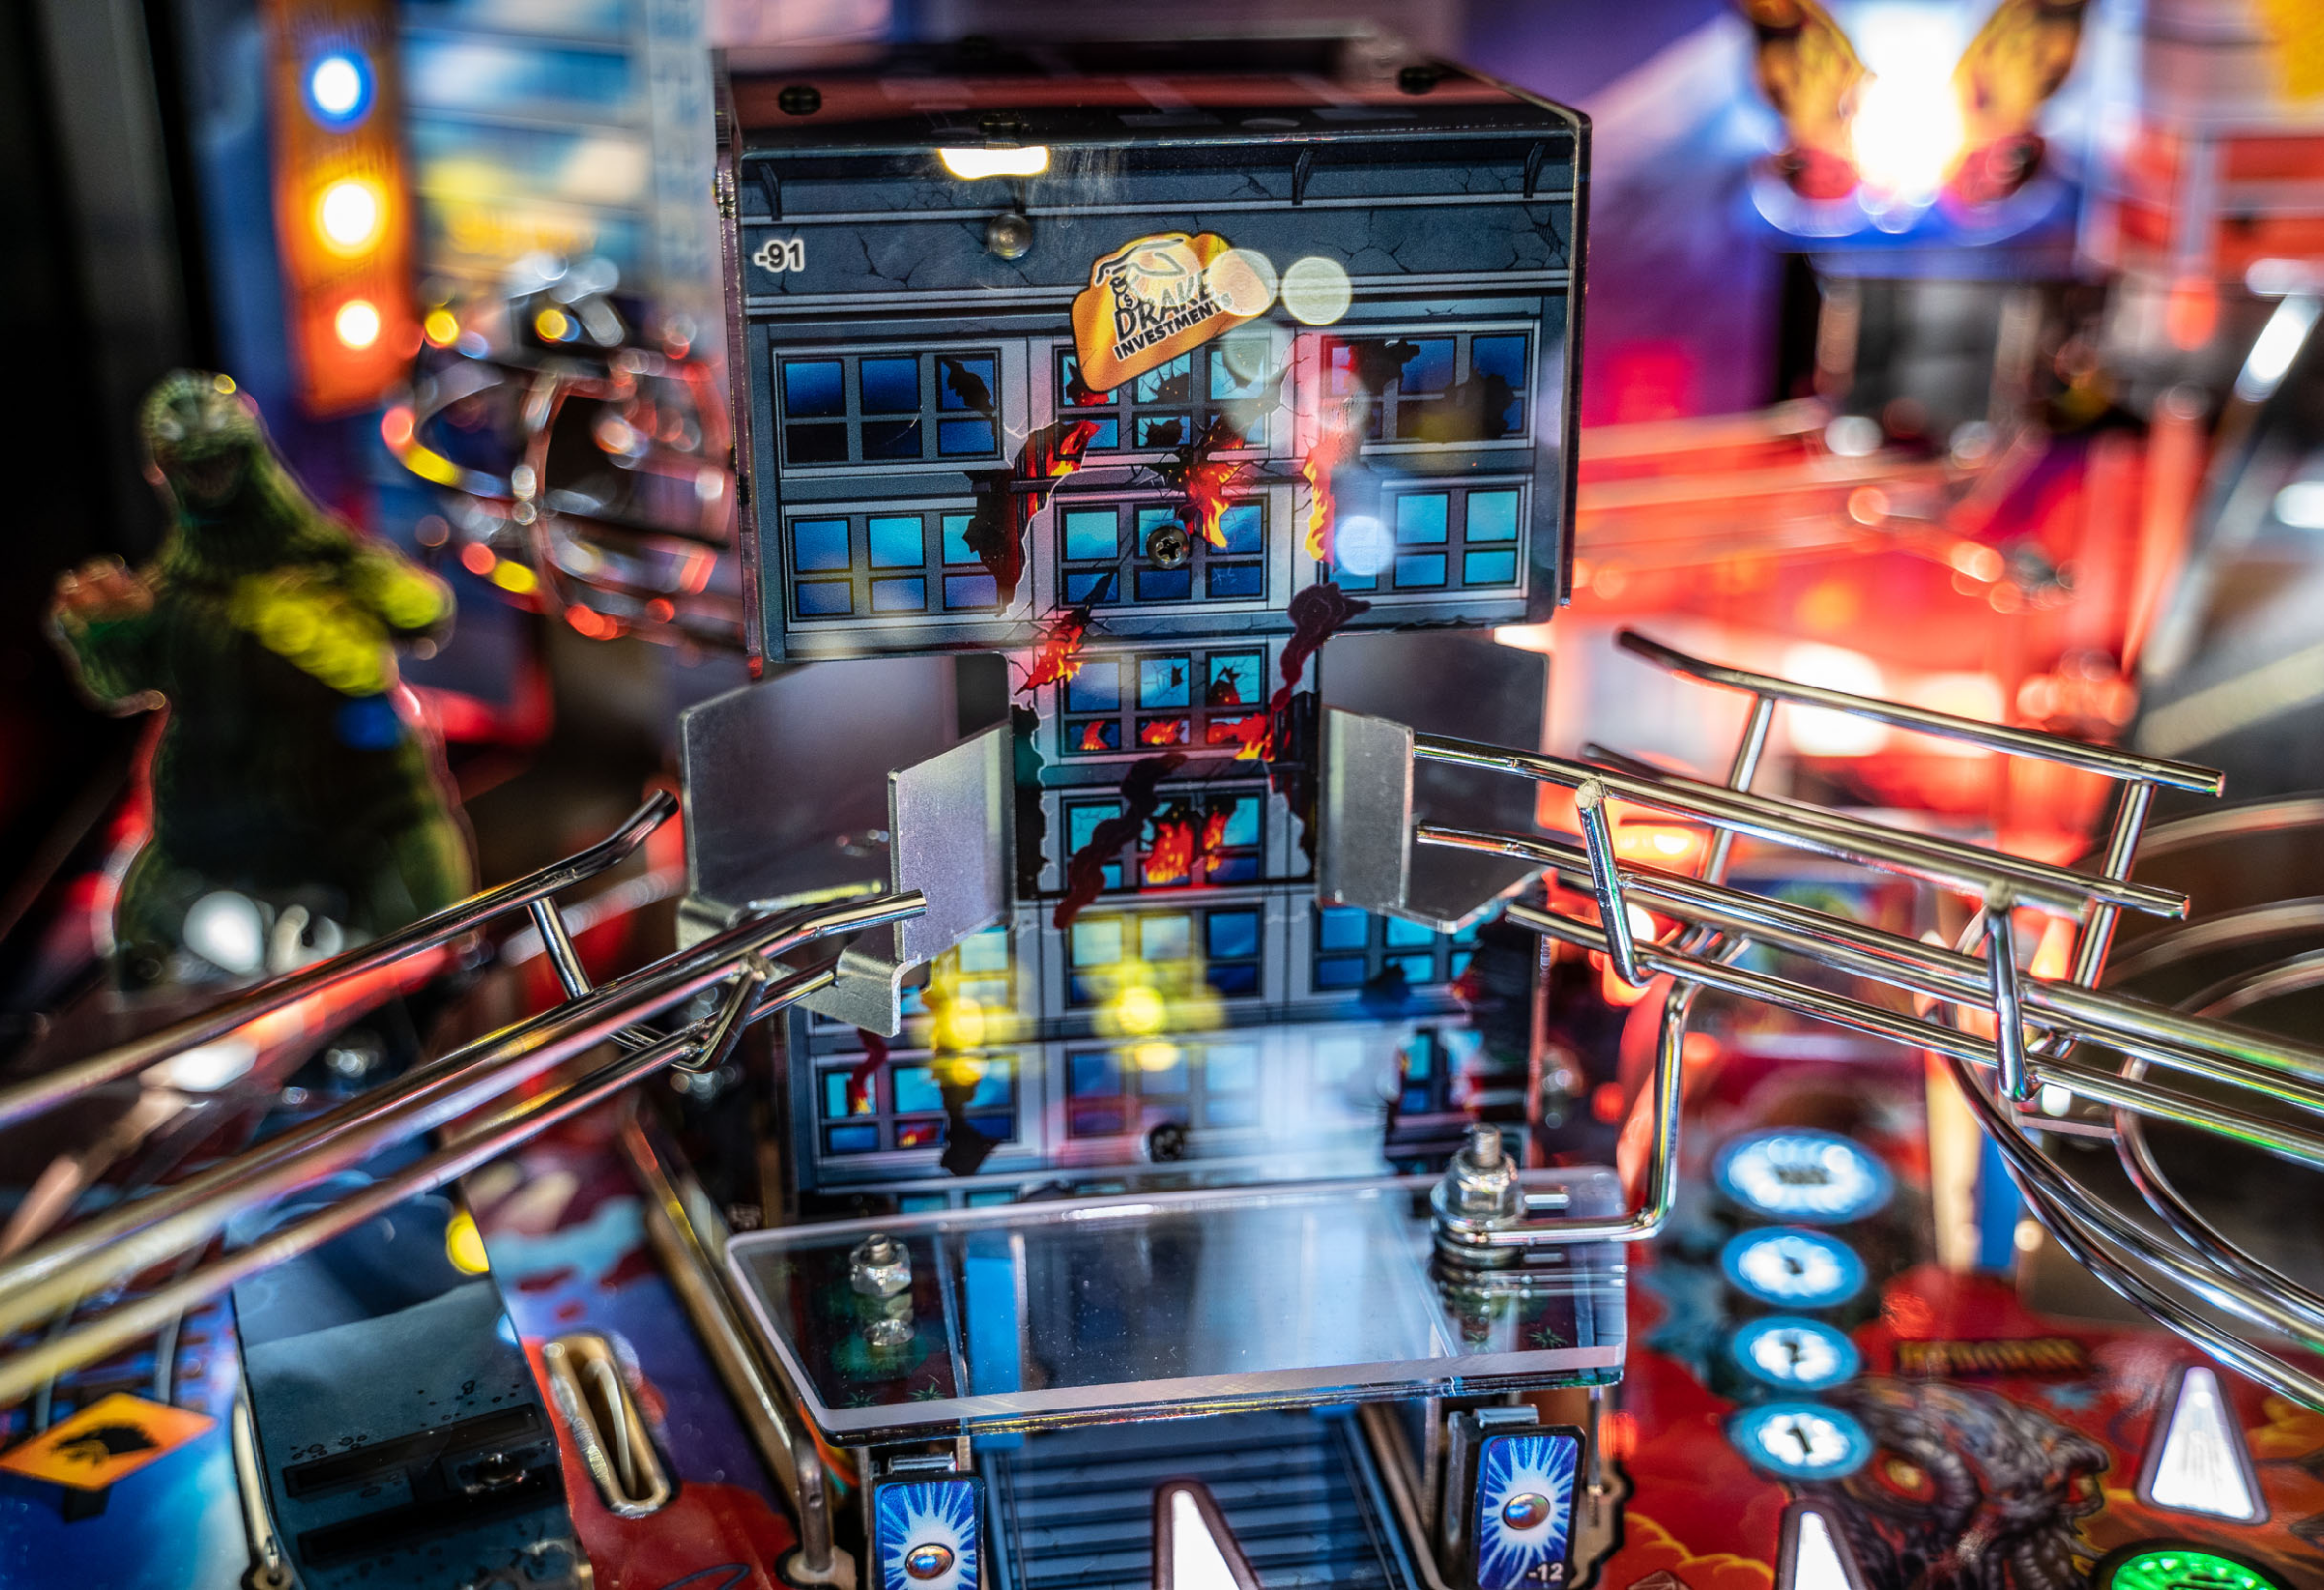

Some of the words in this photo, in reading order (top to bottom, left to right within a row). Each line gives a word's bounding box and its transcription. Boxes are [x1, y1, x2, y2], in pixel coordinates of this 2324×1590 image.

[756, 241, 803, 270] -91
[1113, 291, 1233, 361] INVESTMENTS
[1114, 267, 1212, 342] DRAKE
[1528, 1562, 1564, 1581] -12
